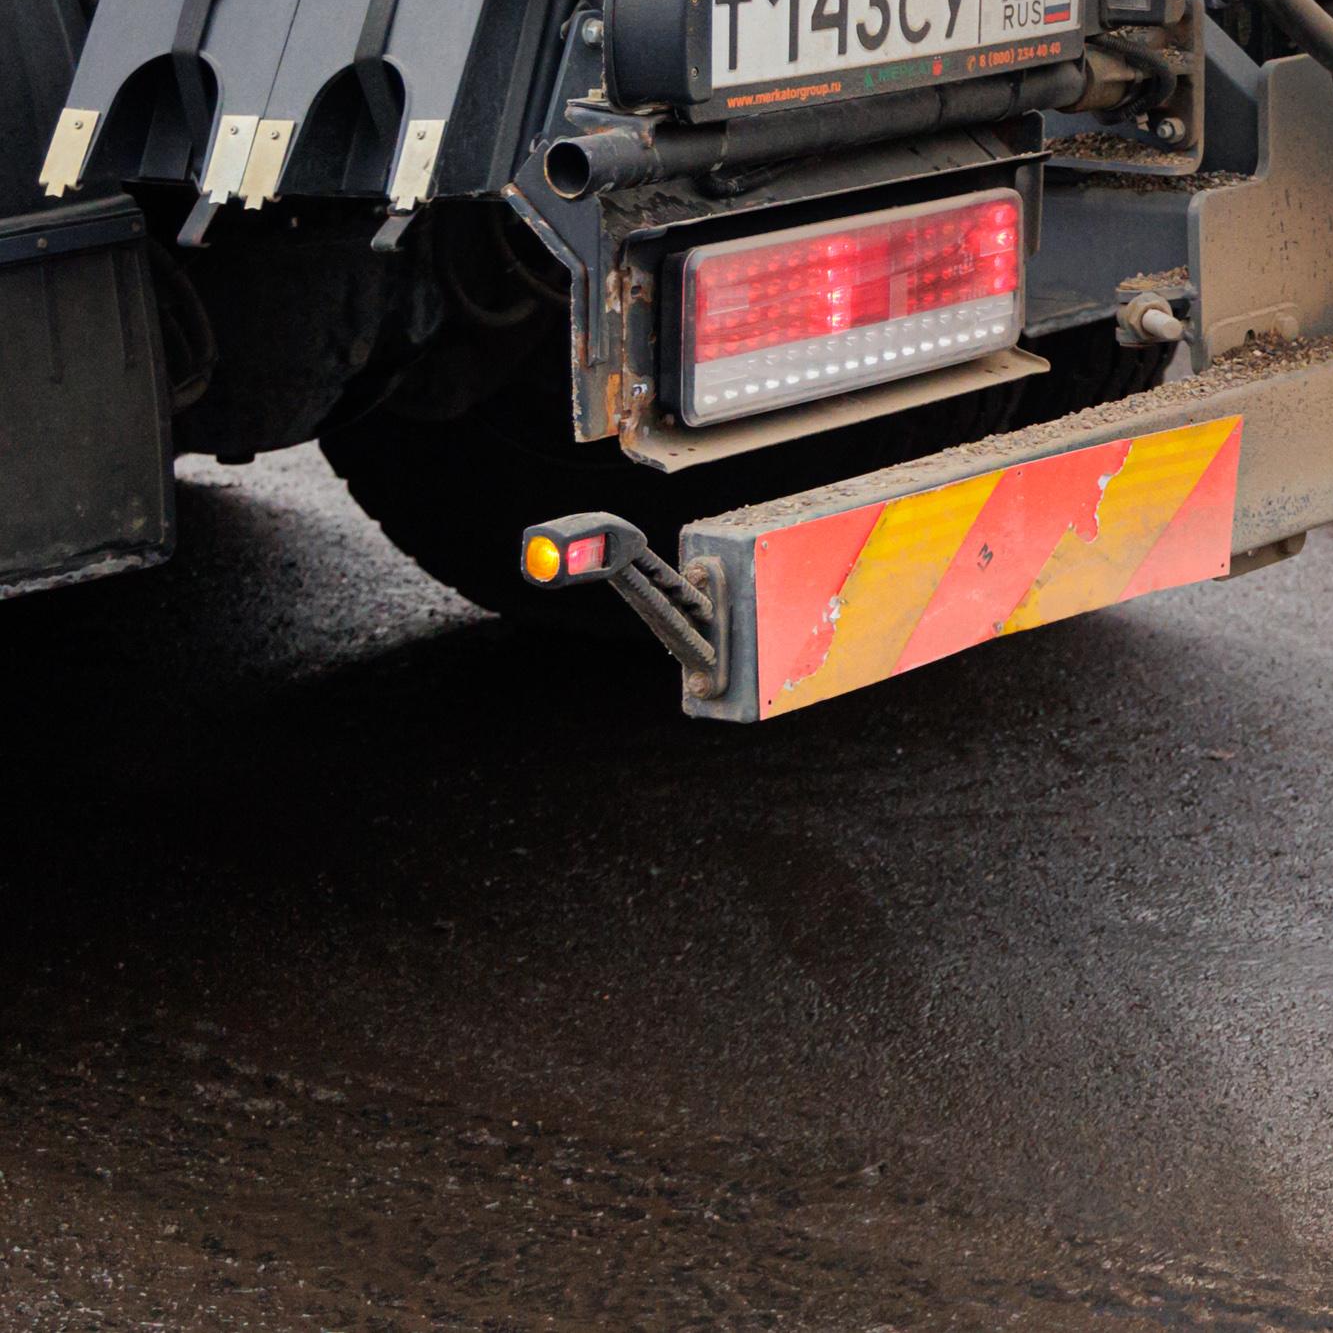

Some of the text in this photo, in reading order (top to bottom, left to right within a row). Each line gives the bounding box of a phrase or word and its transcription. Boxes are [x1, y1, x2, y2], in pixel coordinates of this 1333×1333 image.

[1003, 0, 1042, 30] RUS
[978, 53, 987, 68] 8
[1036, 43, 1048, 58] 40
[1049, 41, 1061, 55] 40
[726, 81, 842, 108] www.merkatorgroup.ru
